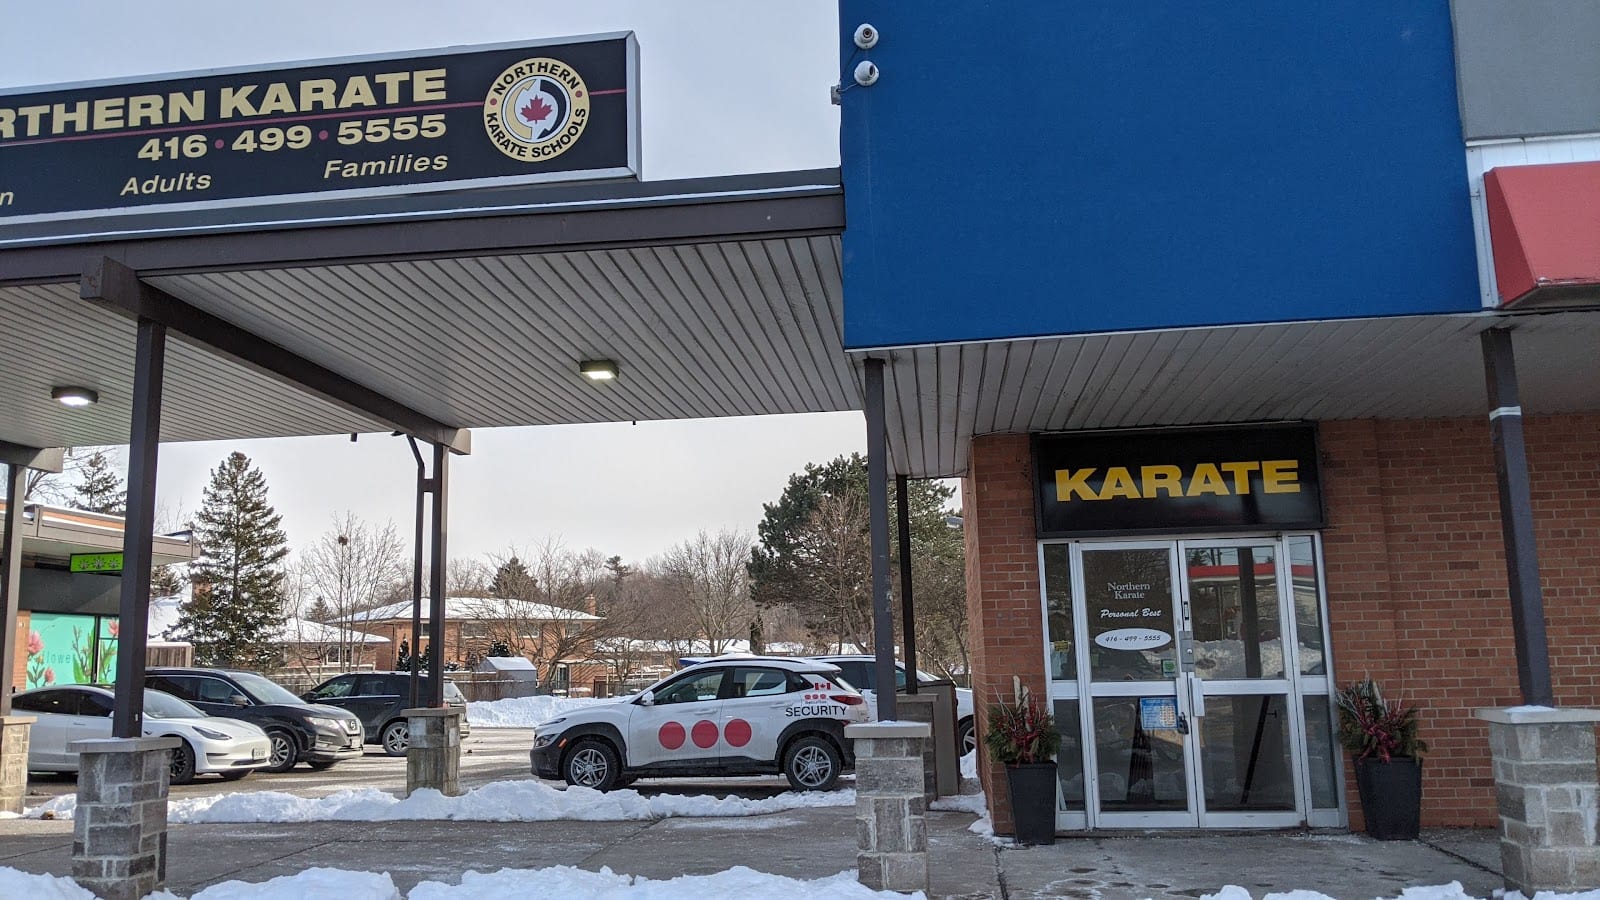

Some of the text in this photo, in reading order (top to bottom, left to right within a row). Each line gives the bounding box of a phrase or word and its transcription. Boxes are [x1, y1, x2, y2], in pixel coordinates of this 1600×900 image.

[220, 68, 447, 119] KARATE
[493, 61, 580, 96] NORTHERN
[137, 113, 447, 161] 416 499 5555
[486, 107, 586, 158] KARATE SCHOOLS
[119, 172, 212, 196] Adults
[323, 153, 448, 179] Families
[1055, 459, 1301, 502] KARATE
[1107, 582, 1150, 591] Northern
[1114, 590, 1145, 600] Karate
[1100, 607, 1162, 618] Personal Best
[42, 650, 76, 664] lowe
[785, 705, 847, 717] SECURITY
